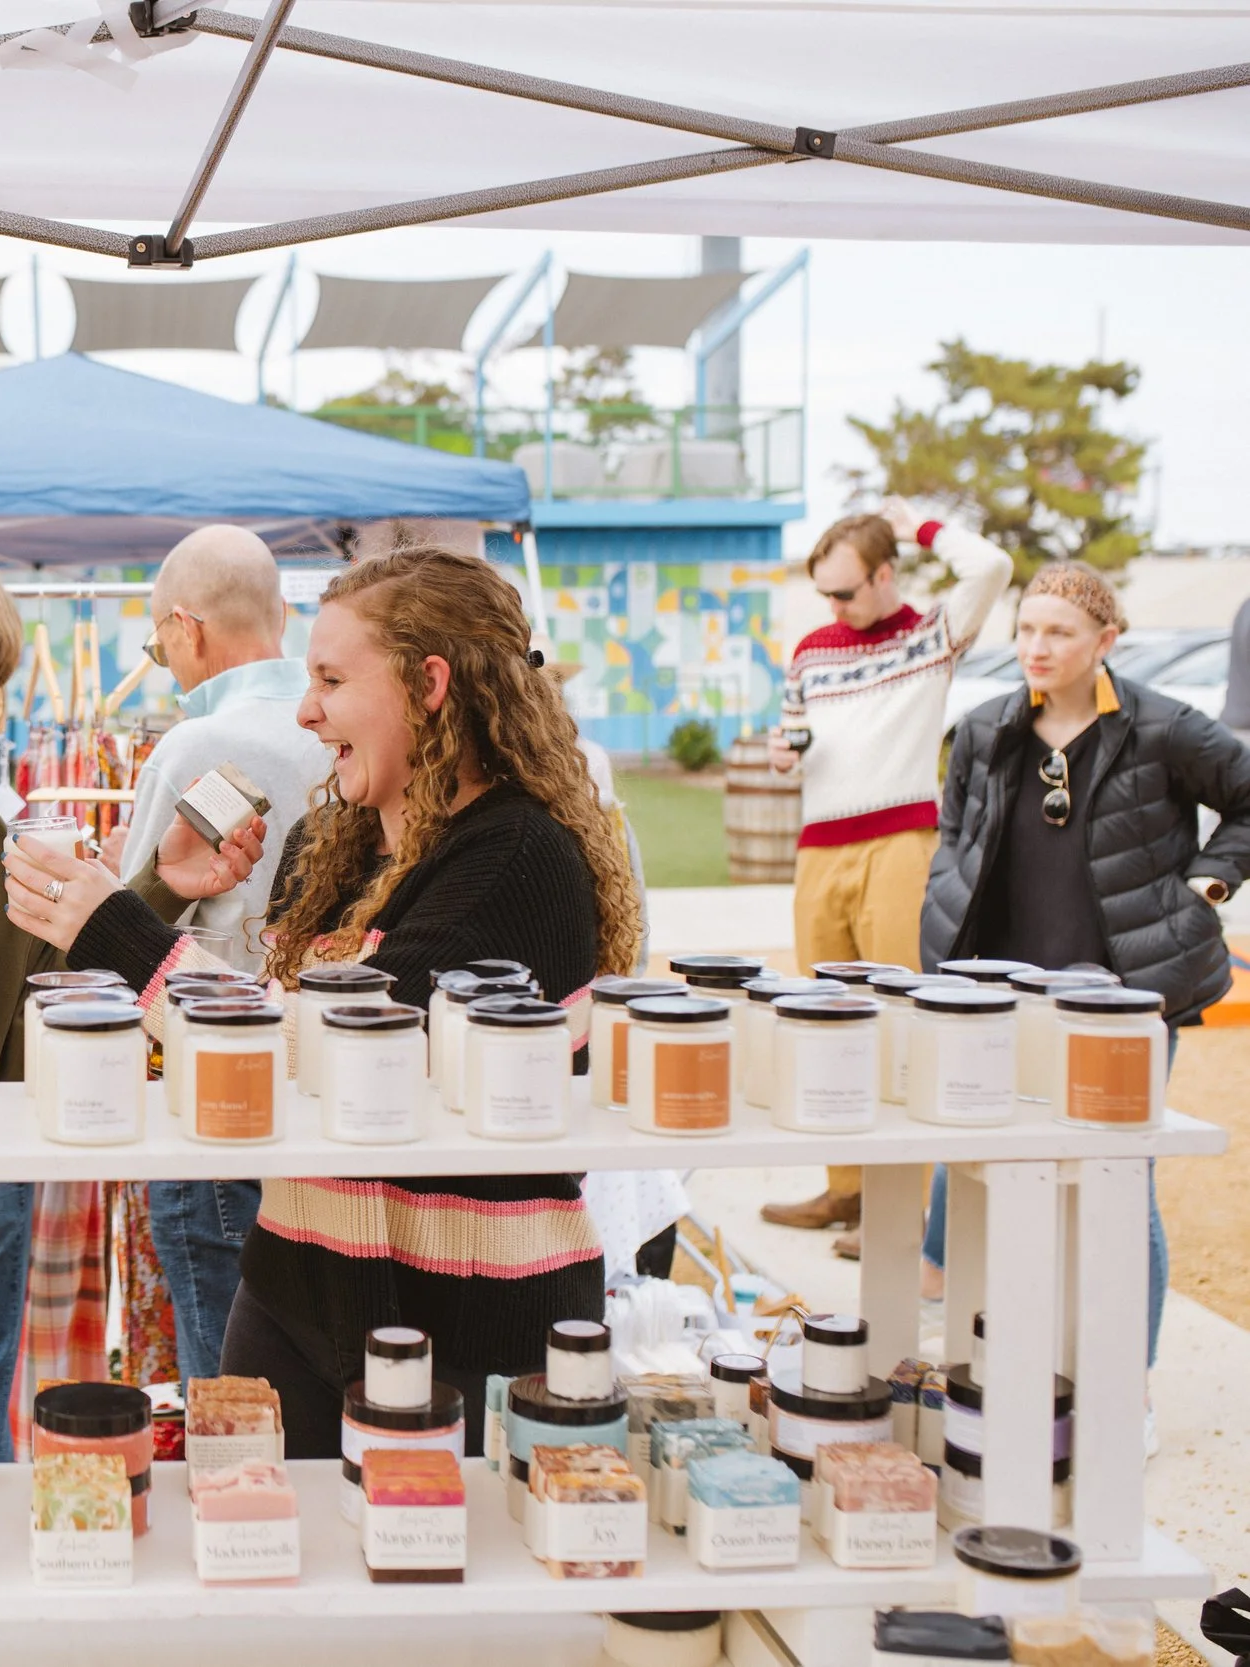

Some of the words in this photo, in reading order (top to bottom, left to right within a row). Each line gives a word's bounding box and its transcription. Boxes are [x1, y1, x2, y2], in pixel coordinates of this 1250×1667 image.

[374, 1529, 423, 1550] Mango
[589, 1525, 618, 1547] Joy
[711, 1532, 755, 1548] Ocean
[847, 1534, 897, 1555] Honey
[898, 1534, 935, 1550] Love
